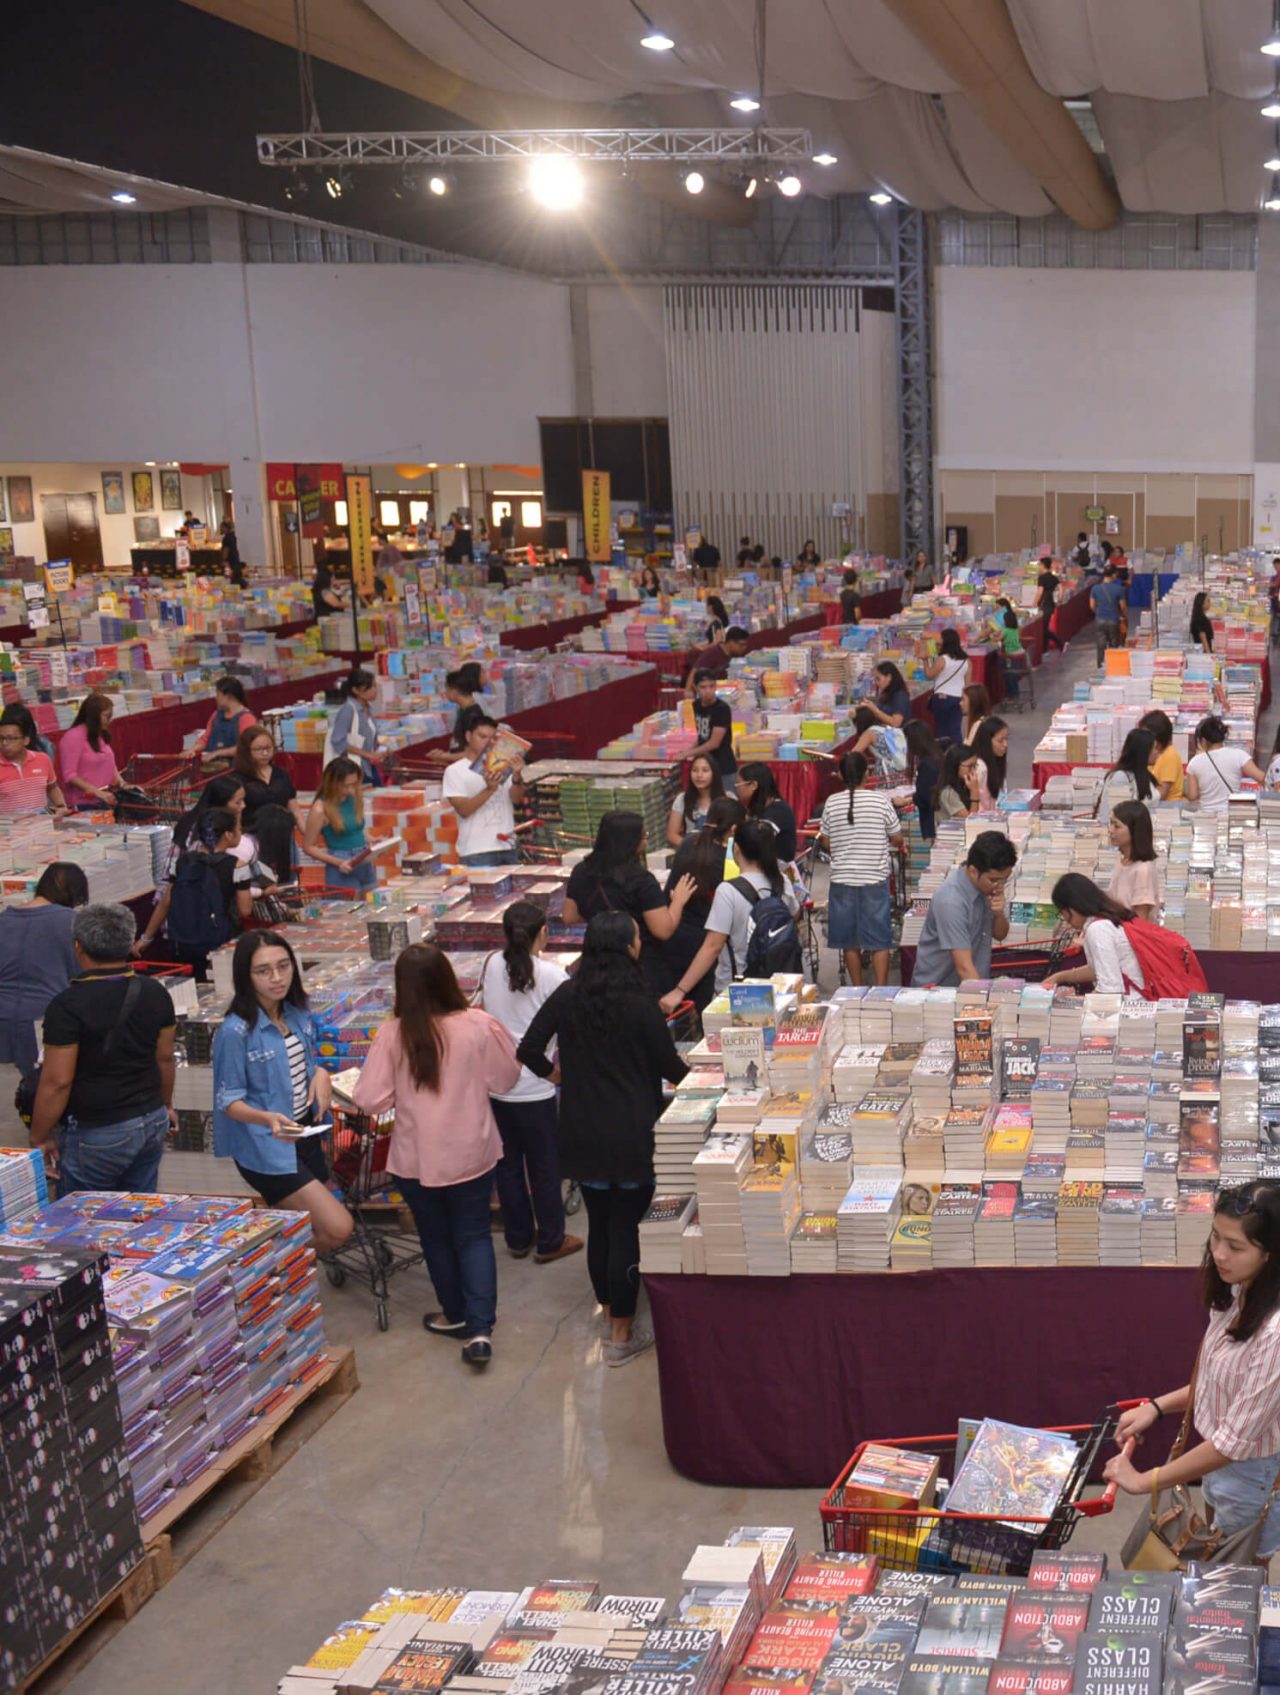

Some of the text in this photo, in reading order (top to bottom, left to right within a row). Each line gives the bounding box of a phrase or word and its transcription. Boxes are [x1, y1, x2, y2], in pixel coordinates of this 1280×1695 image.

[275, 480, 339, 496] CAER
[592, 475, 600, 554] CHILDREN
[778, 1032, 819, 1042] TARGET
[1006, 1062, 1036, 1075] JACK
[860, 1103, 901, 1111] GATES
[1060, 1182, 1103, 1191] GOLD
[819, 1569, 846, 1578] KILLER
[888, 1571, 945, 1584] ALONE
[1033, 1571, 1096, 1583] ABDUCTION
[794, 1575, 863, 1586] SLEEPING BEAUTY
[960, 1581, 985, 1589] BOYD
[598, 1599, 660, 1614] TUROW
[853, 1595, 916, 1606] ALONE
[932, 1596, 1007, 1606] WILLIAM BOYD
[1102, 1596, 1160, 1613] CLASS
[785, 1618, 814, 1628] KILLER
[1014, 1613, 1082, 1625] ABDUCTION
[1098, 1613, 1159, 1626] DIFFERENT
[648, 1630, 717, 1643] KILLER
[760, 1625, 834, 1638] SLEEPING BEAUTY
[407, 1640, 463, 1652] MARIANI
[645, 1640, 711, 1651] CRUCIFIX
[757, 1645, 819, 1656] CLARK
[838, 1641, 901, 1652] CLARK
[397, 1655, 452, 1669] LEGACY
[1087, 1647, 1150, 1666] CLASS
[522, 1661, 573, 1675] SCOTT
[580, 1656, 632, 1671] SSFIRE
[829, 1657, 895, 1672] ALONE
[1195, 1662, 1227, 1674] Traitor
[823, 1667, 876, 1679] MYSELF,
[909, 1663, 990, 1677] WILLIAM BOYD
[1086, 1666, 1149, 1679] DIFFERENT
[606, 1680, 681, 1694] KILLER
[997, 1677, 1068, 1691] ABDUCTION
[1085, 1683, 1149, 1695] HARRIS
